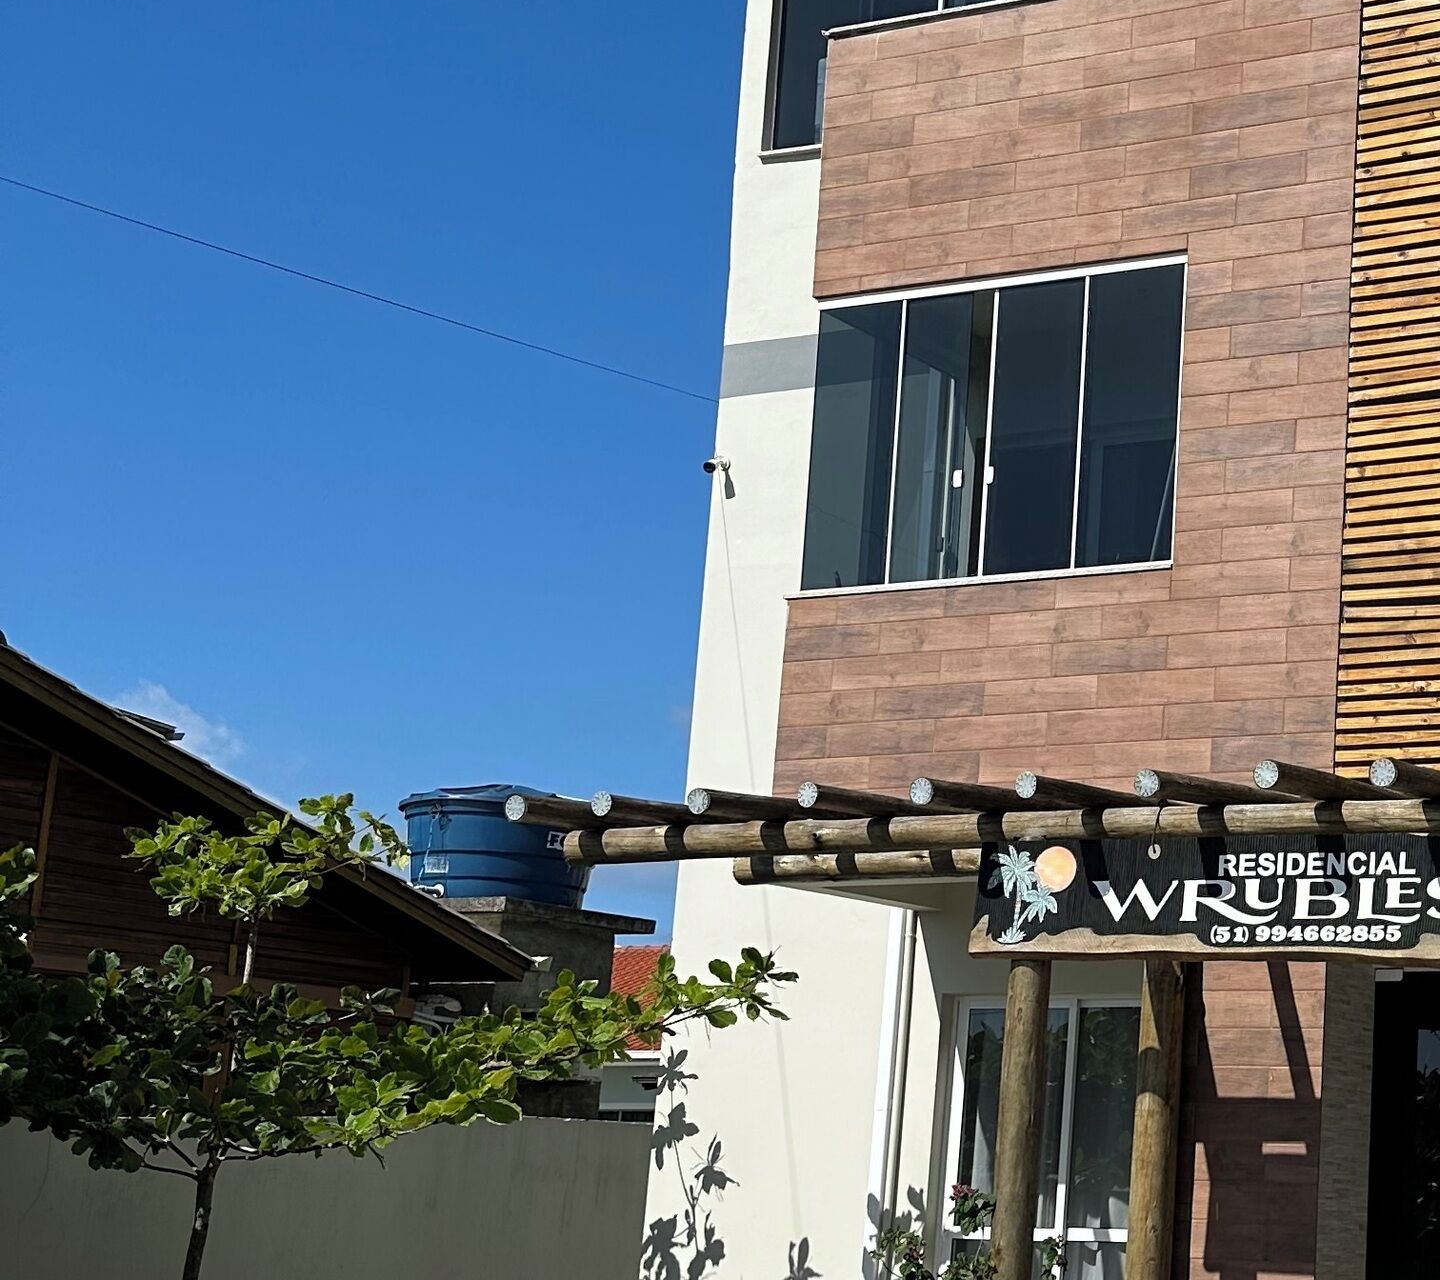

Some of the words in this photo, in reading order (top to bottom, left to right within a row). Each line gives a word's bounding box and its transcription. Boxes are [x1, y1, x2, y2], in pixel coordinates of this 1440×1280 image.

[1218, 851, 1416, 877] RESIDENCIAL
[1210, 925, 1249, 944] (51)
[1255, 924, 1402, 943] 994662855
